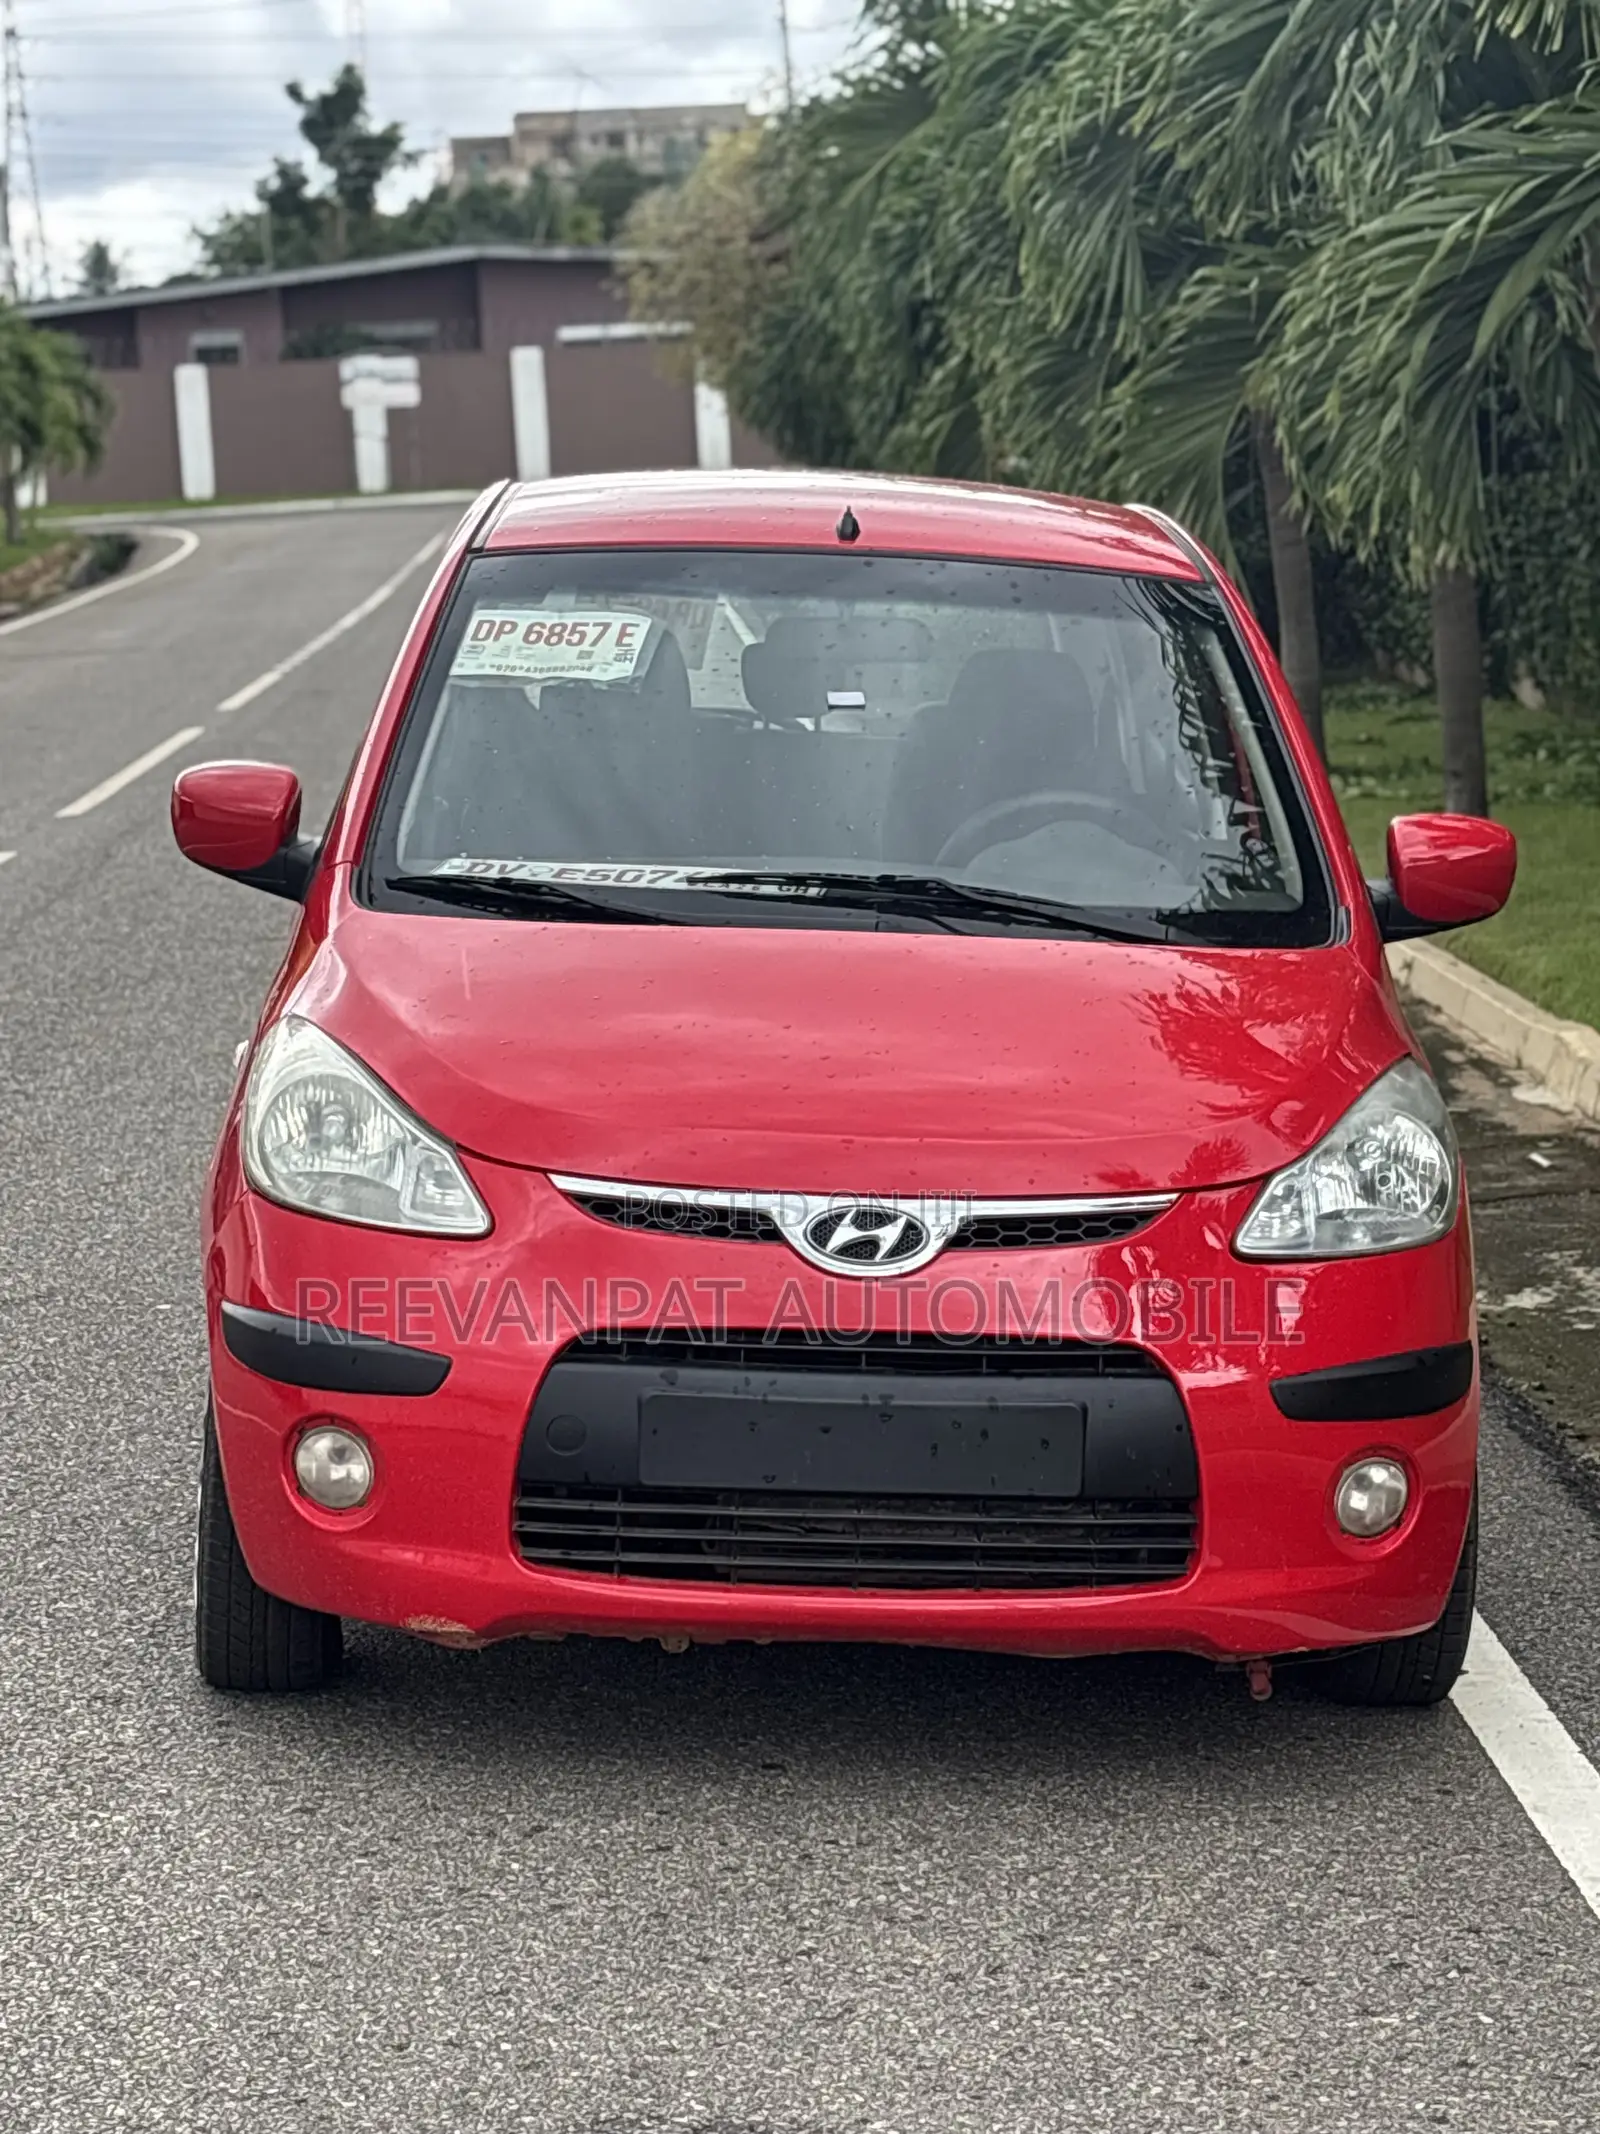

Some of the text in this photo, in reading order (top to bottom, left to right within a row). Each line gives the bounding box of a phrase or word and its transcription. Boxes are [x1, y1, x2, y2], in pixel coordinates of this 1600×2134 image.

[470, 619, 640, 648] DP 6857 E
[461, 861, 528, 877] DV
